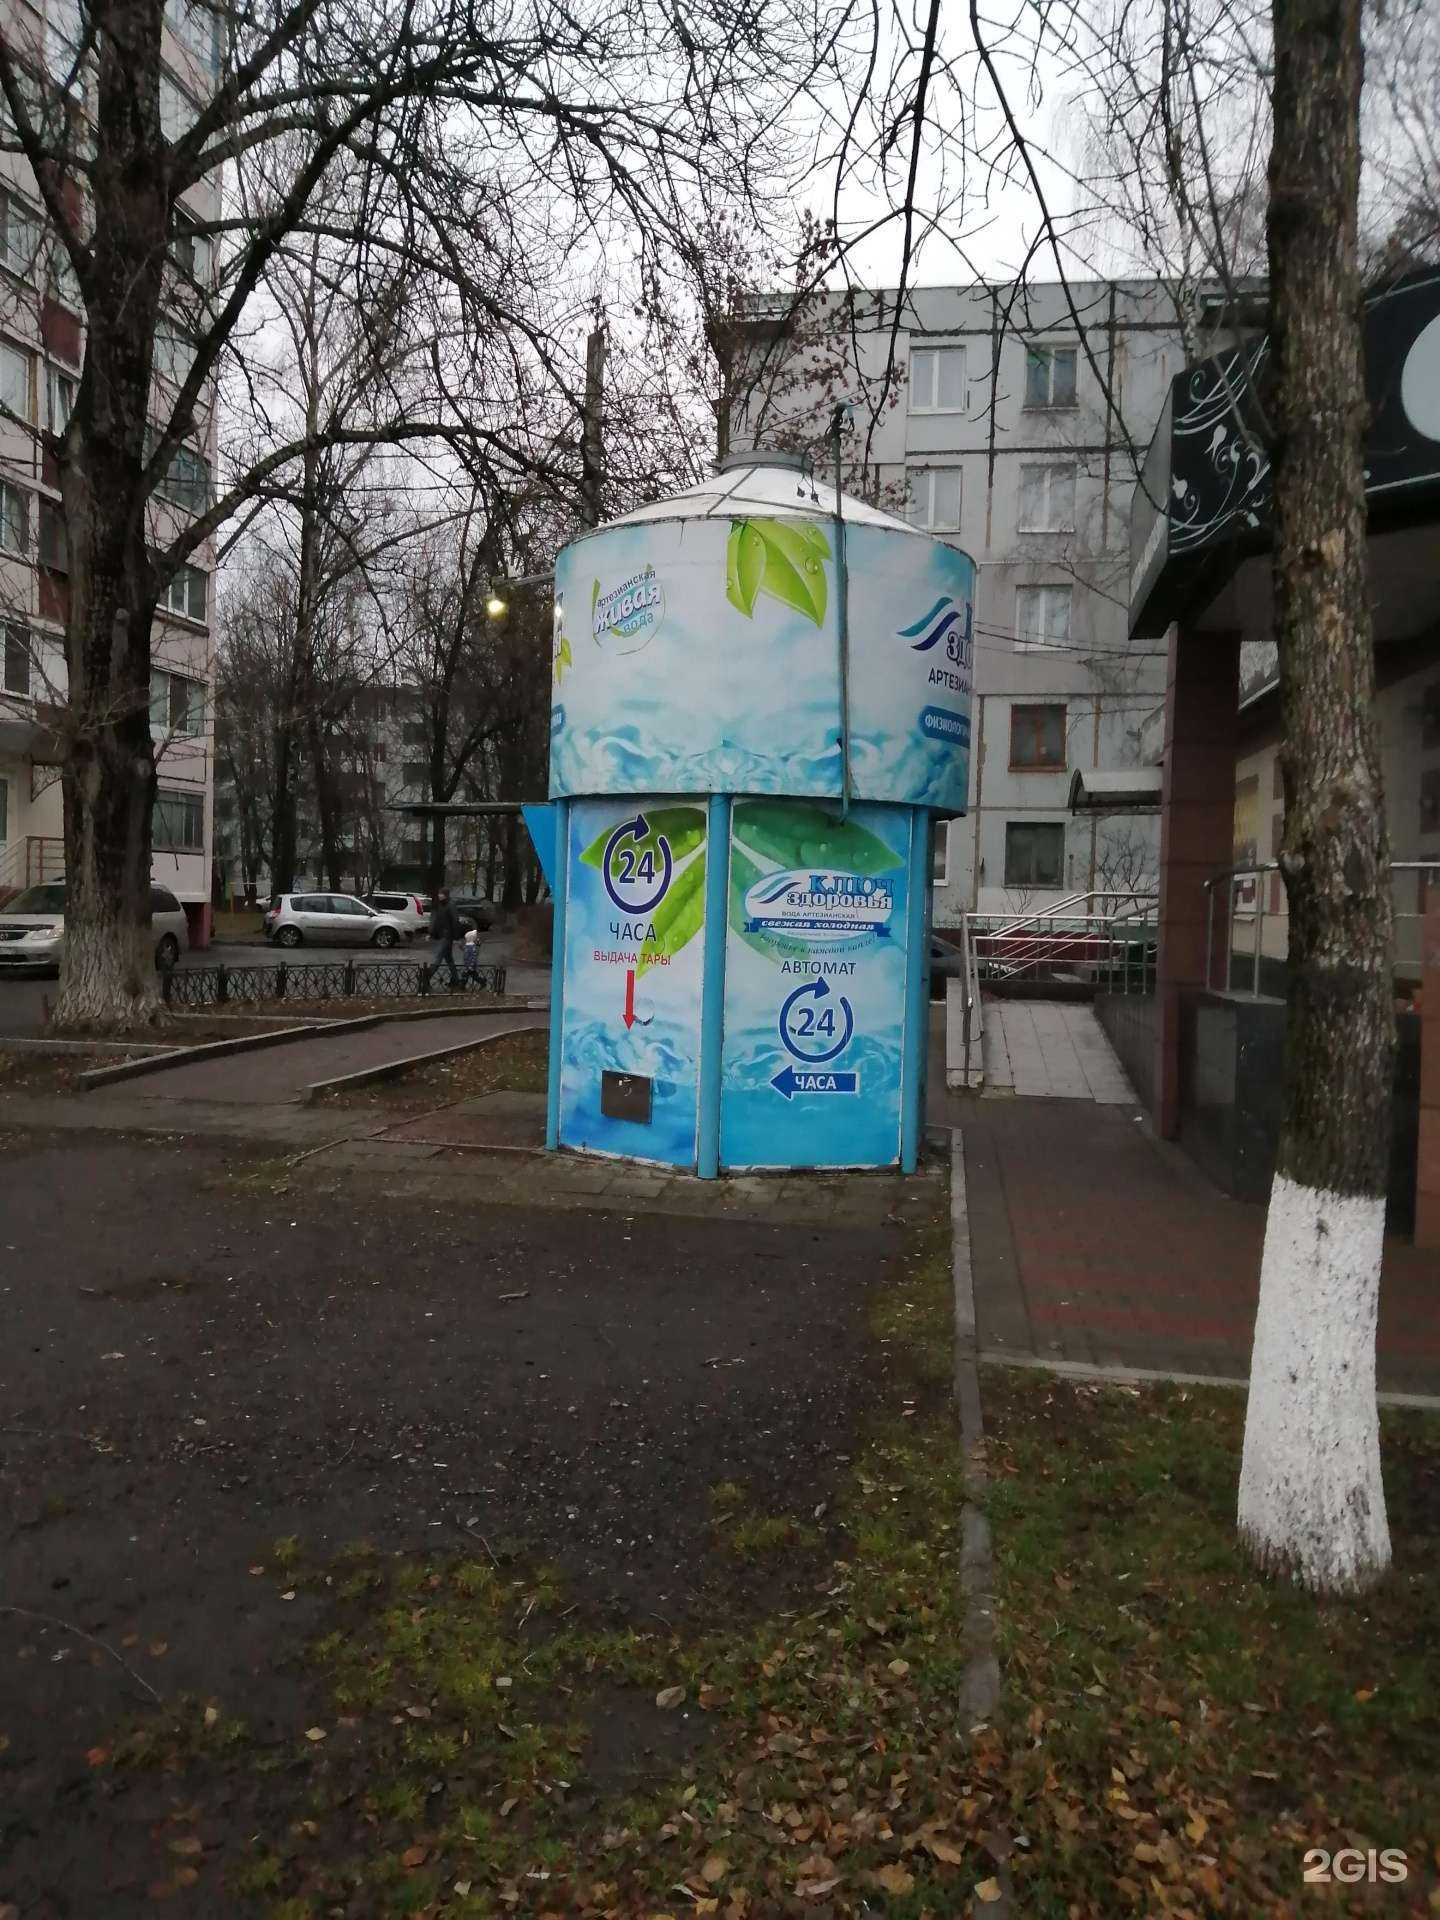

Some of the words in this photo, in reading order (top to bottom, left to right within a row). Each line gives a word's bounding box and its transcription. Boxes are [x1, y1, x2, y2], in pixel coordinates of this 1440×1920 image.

[618, 850, 656, 885] 24
[809, 875, 895, 896] КЛЮЧ
[610, 922, 657, 942] ЧАСА
[593, 951, 638, 964] ВЫДАЧА
[640, 953, 671, 966] ТАРЫ
[781, 960, 857, 975] АВТОМАТ
[797, 1007, 836, 1037] 24
[795, 1075, 837, 1090] ЧАСА
